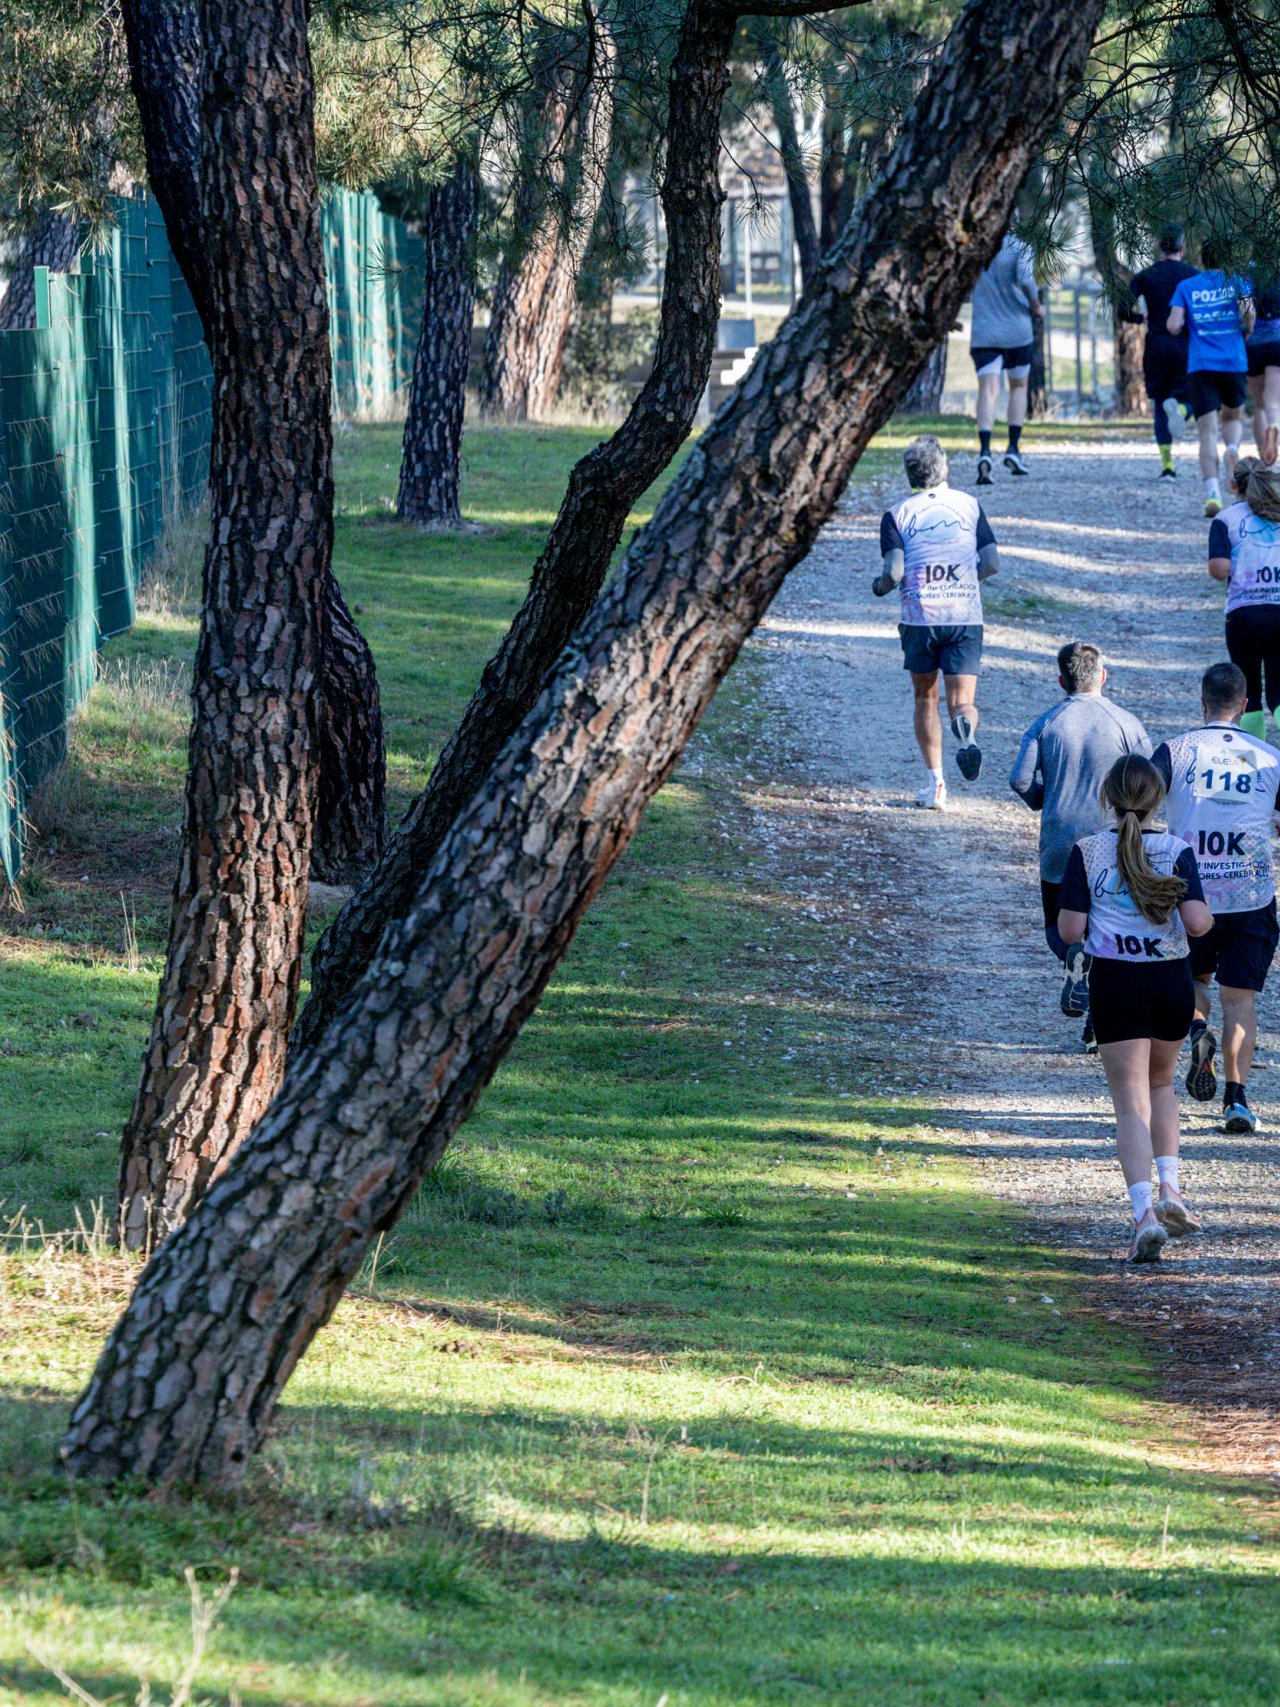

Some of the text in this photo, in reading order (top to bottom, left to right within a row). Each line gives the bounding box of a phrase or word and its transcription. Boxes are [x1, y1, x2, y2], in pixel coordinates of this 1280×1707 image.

[926, 564, 961, 584] 10K
[1200, 768, 1252, 794] 118
[1198, 831, 1247, 856] 10K
[1114, 934, 1165, 958] 10K
